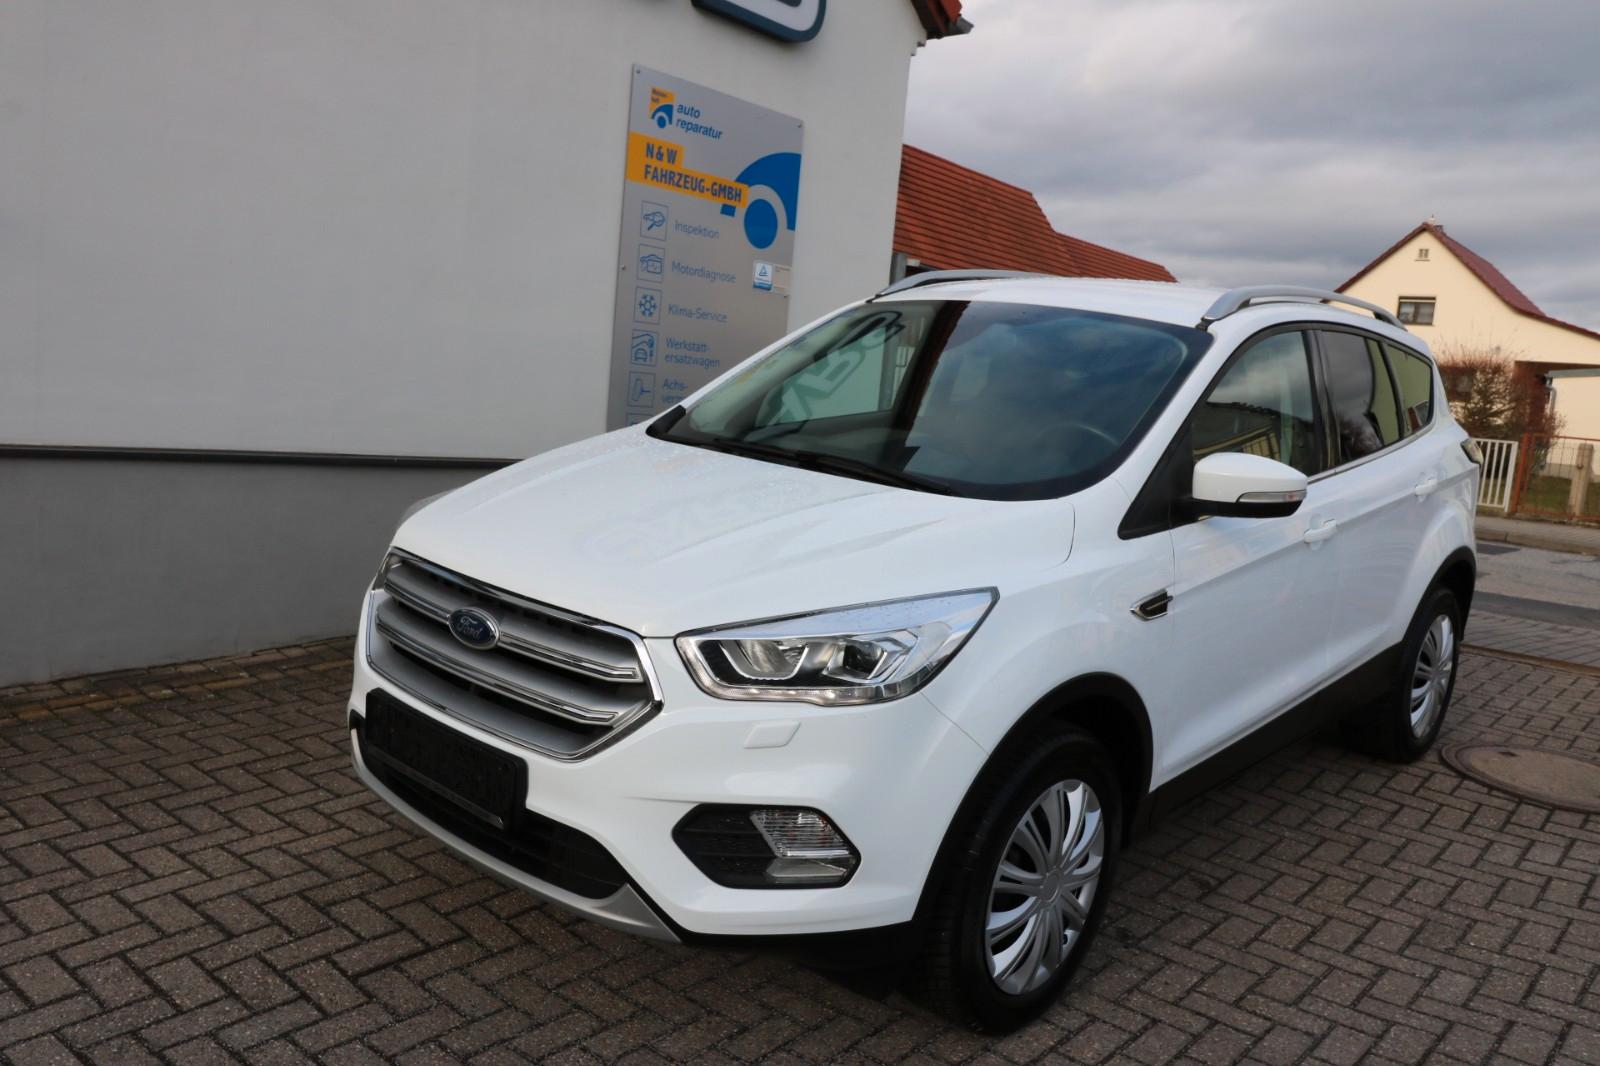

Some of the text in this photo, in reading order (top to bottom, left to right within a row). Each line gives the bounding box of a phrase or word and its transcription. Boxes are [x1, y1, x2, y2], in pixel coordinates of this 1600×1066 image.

[676, 103, 701, 119] auto
[675, 118, 723, 139] reparatur
[645, 142, 678, 165] N & W
[643, 164, 743, 203] FAHRZEUG-GMBH
[674, 219, 720, 240] Inspektion
[671, 260, 737, 283] Motordiagnose
[668, 303, 729, 323] Klima-Service
[665, 337, 711, 353] Werkstatt-
[664, 353, 721, 371] ersatzwagen
